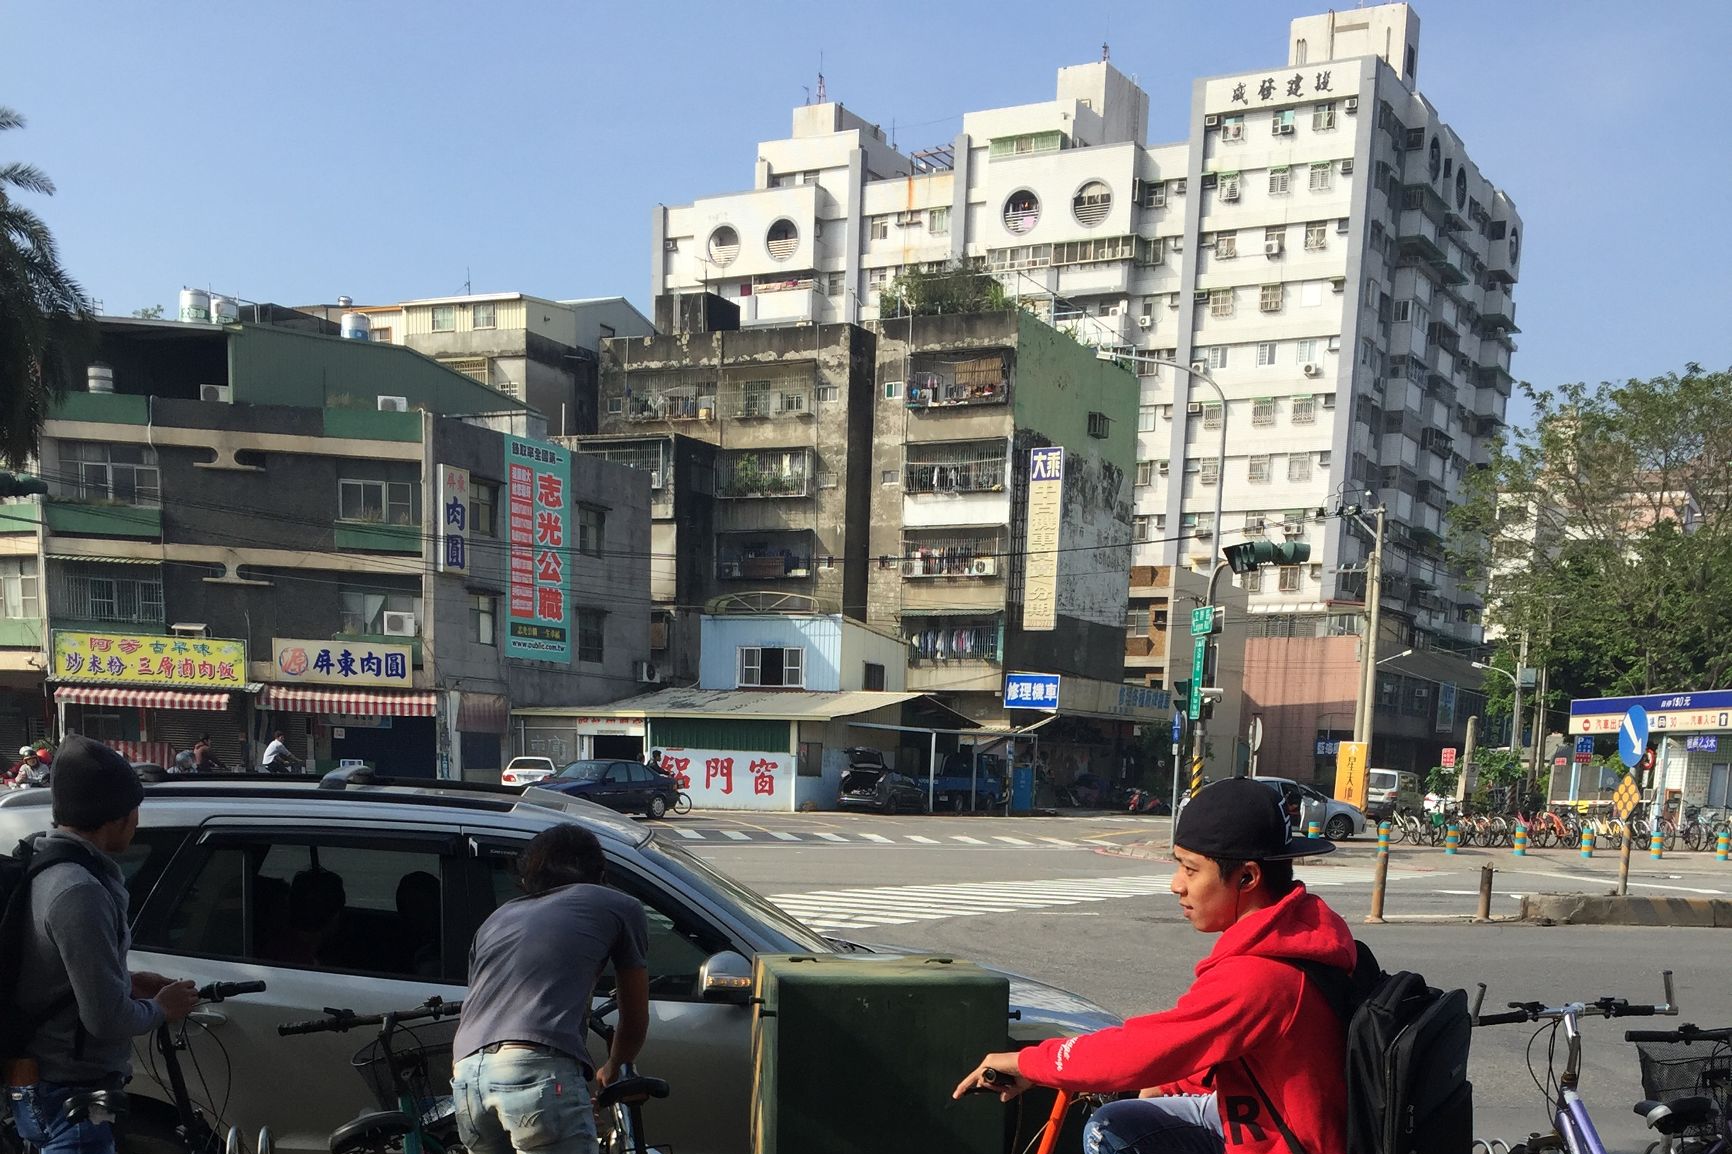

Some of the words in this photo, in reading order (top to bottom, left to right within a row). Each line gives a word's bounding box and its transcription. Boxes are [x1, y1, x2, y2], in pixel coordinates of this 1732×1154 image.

[537, 473, 564, 621] 志光公職
[312, 648, 407, 679] 屏東肉圓
[1007, 682, 1058, 701] 修理機車
